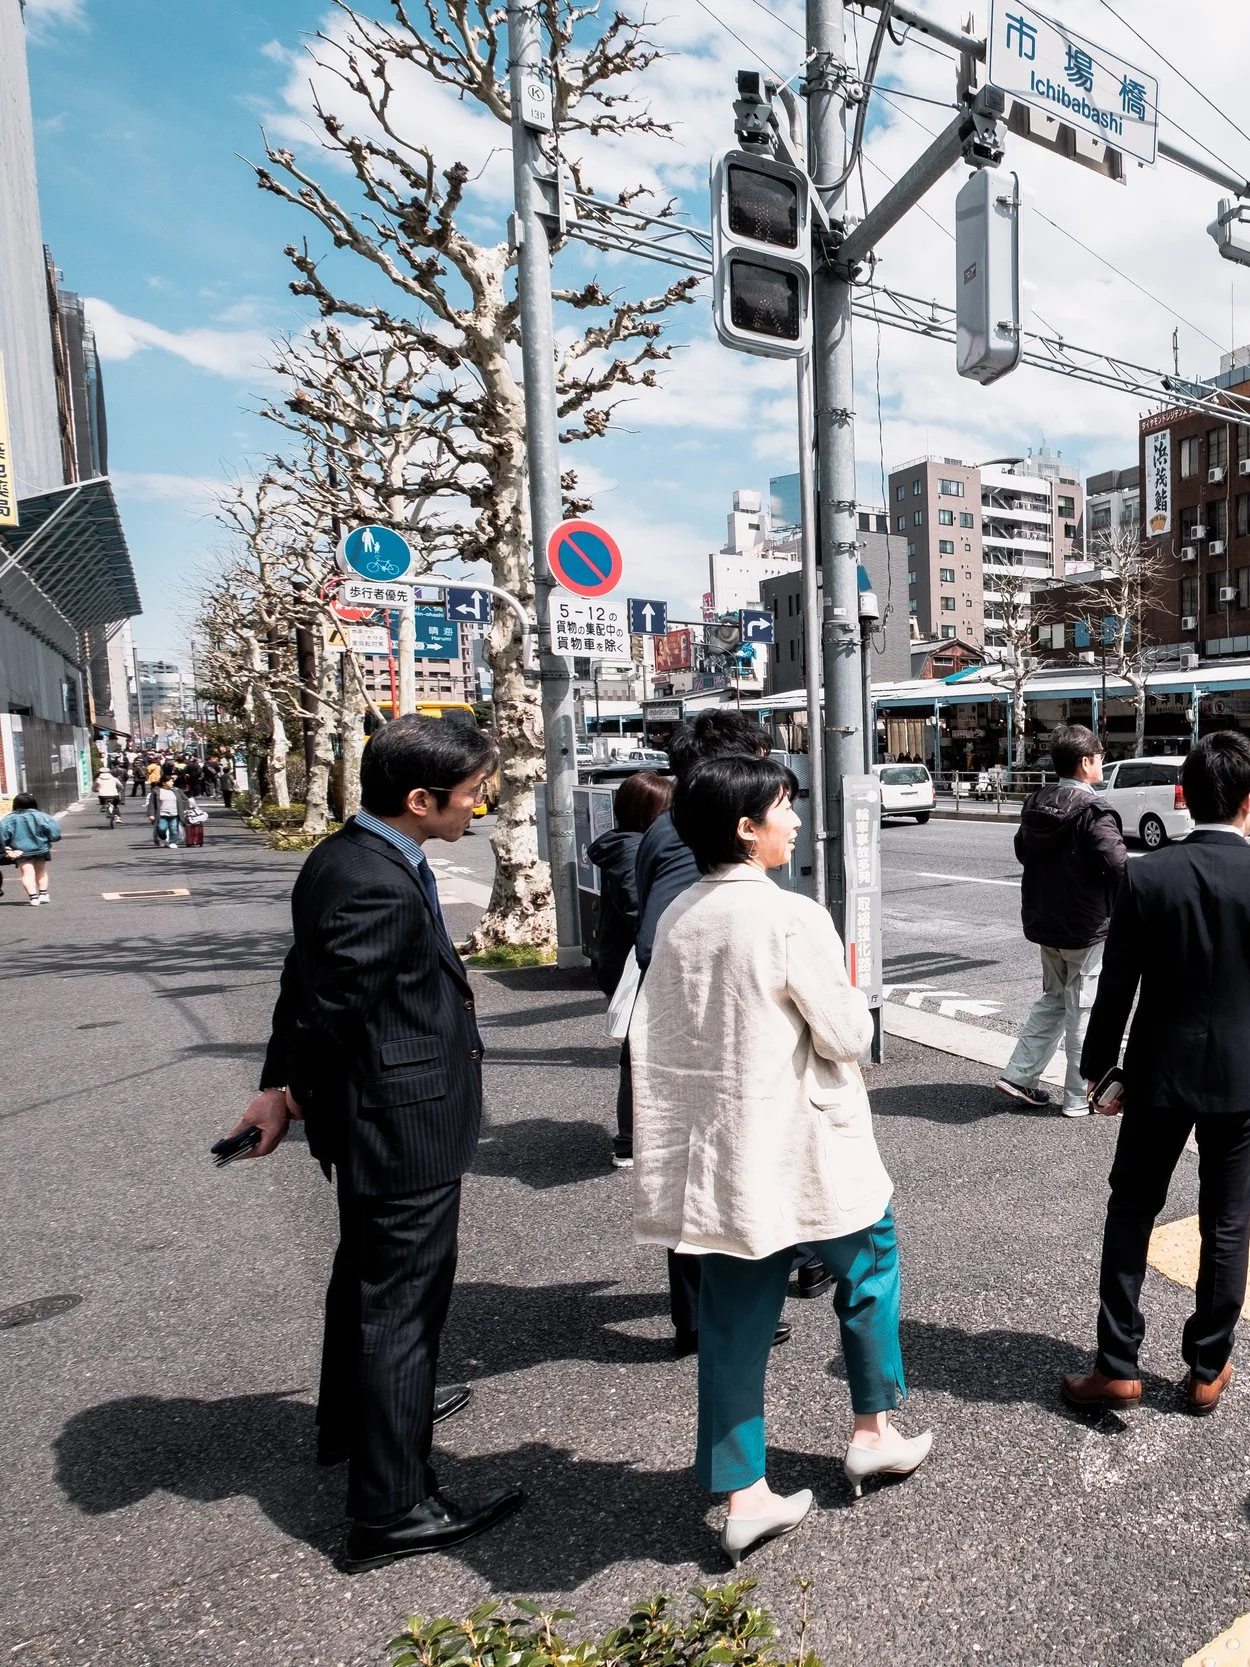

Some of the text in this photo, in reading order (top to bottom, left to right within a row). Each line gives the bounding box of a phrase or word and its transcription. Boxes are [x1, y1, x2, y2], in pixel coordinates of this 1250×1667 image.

[1005, 12, 1147, 121] 市場橋
[1030, 70, 1123, 136] Ichibabashi
[350, 586, 408, 602] 歩行者優先
[556, 619, 624, 638] 貨物の集配中の
[557, 636, 624, 653] 貨物車を除く
